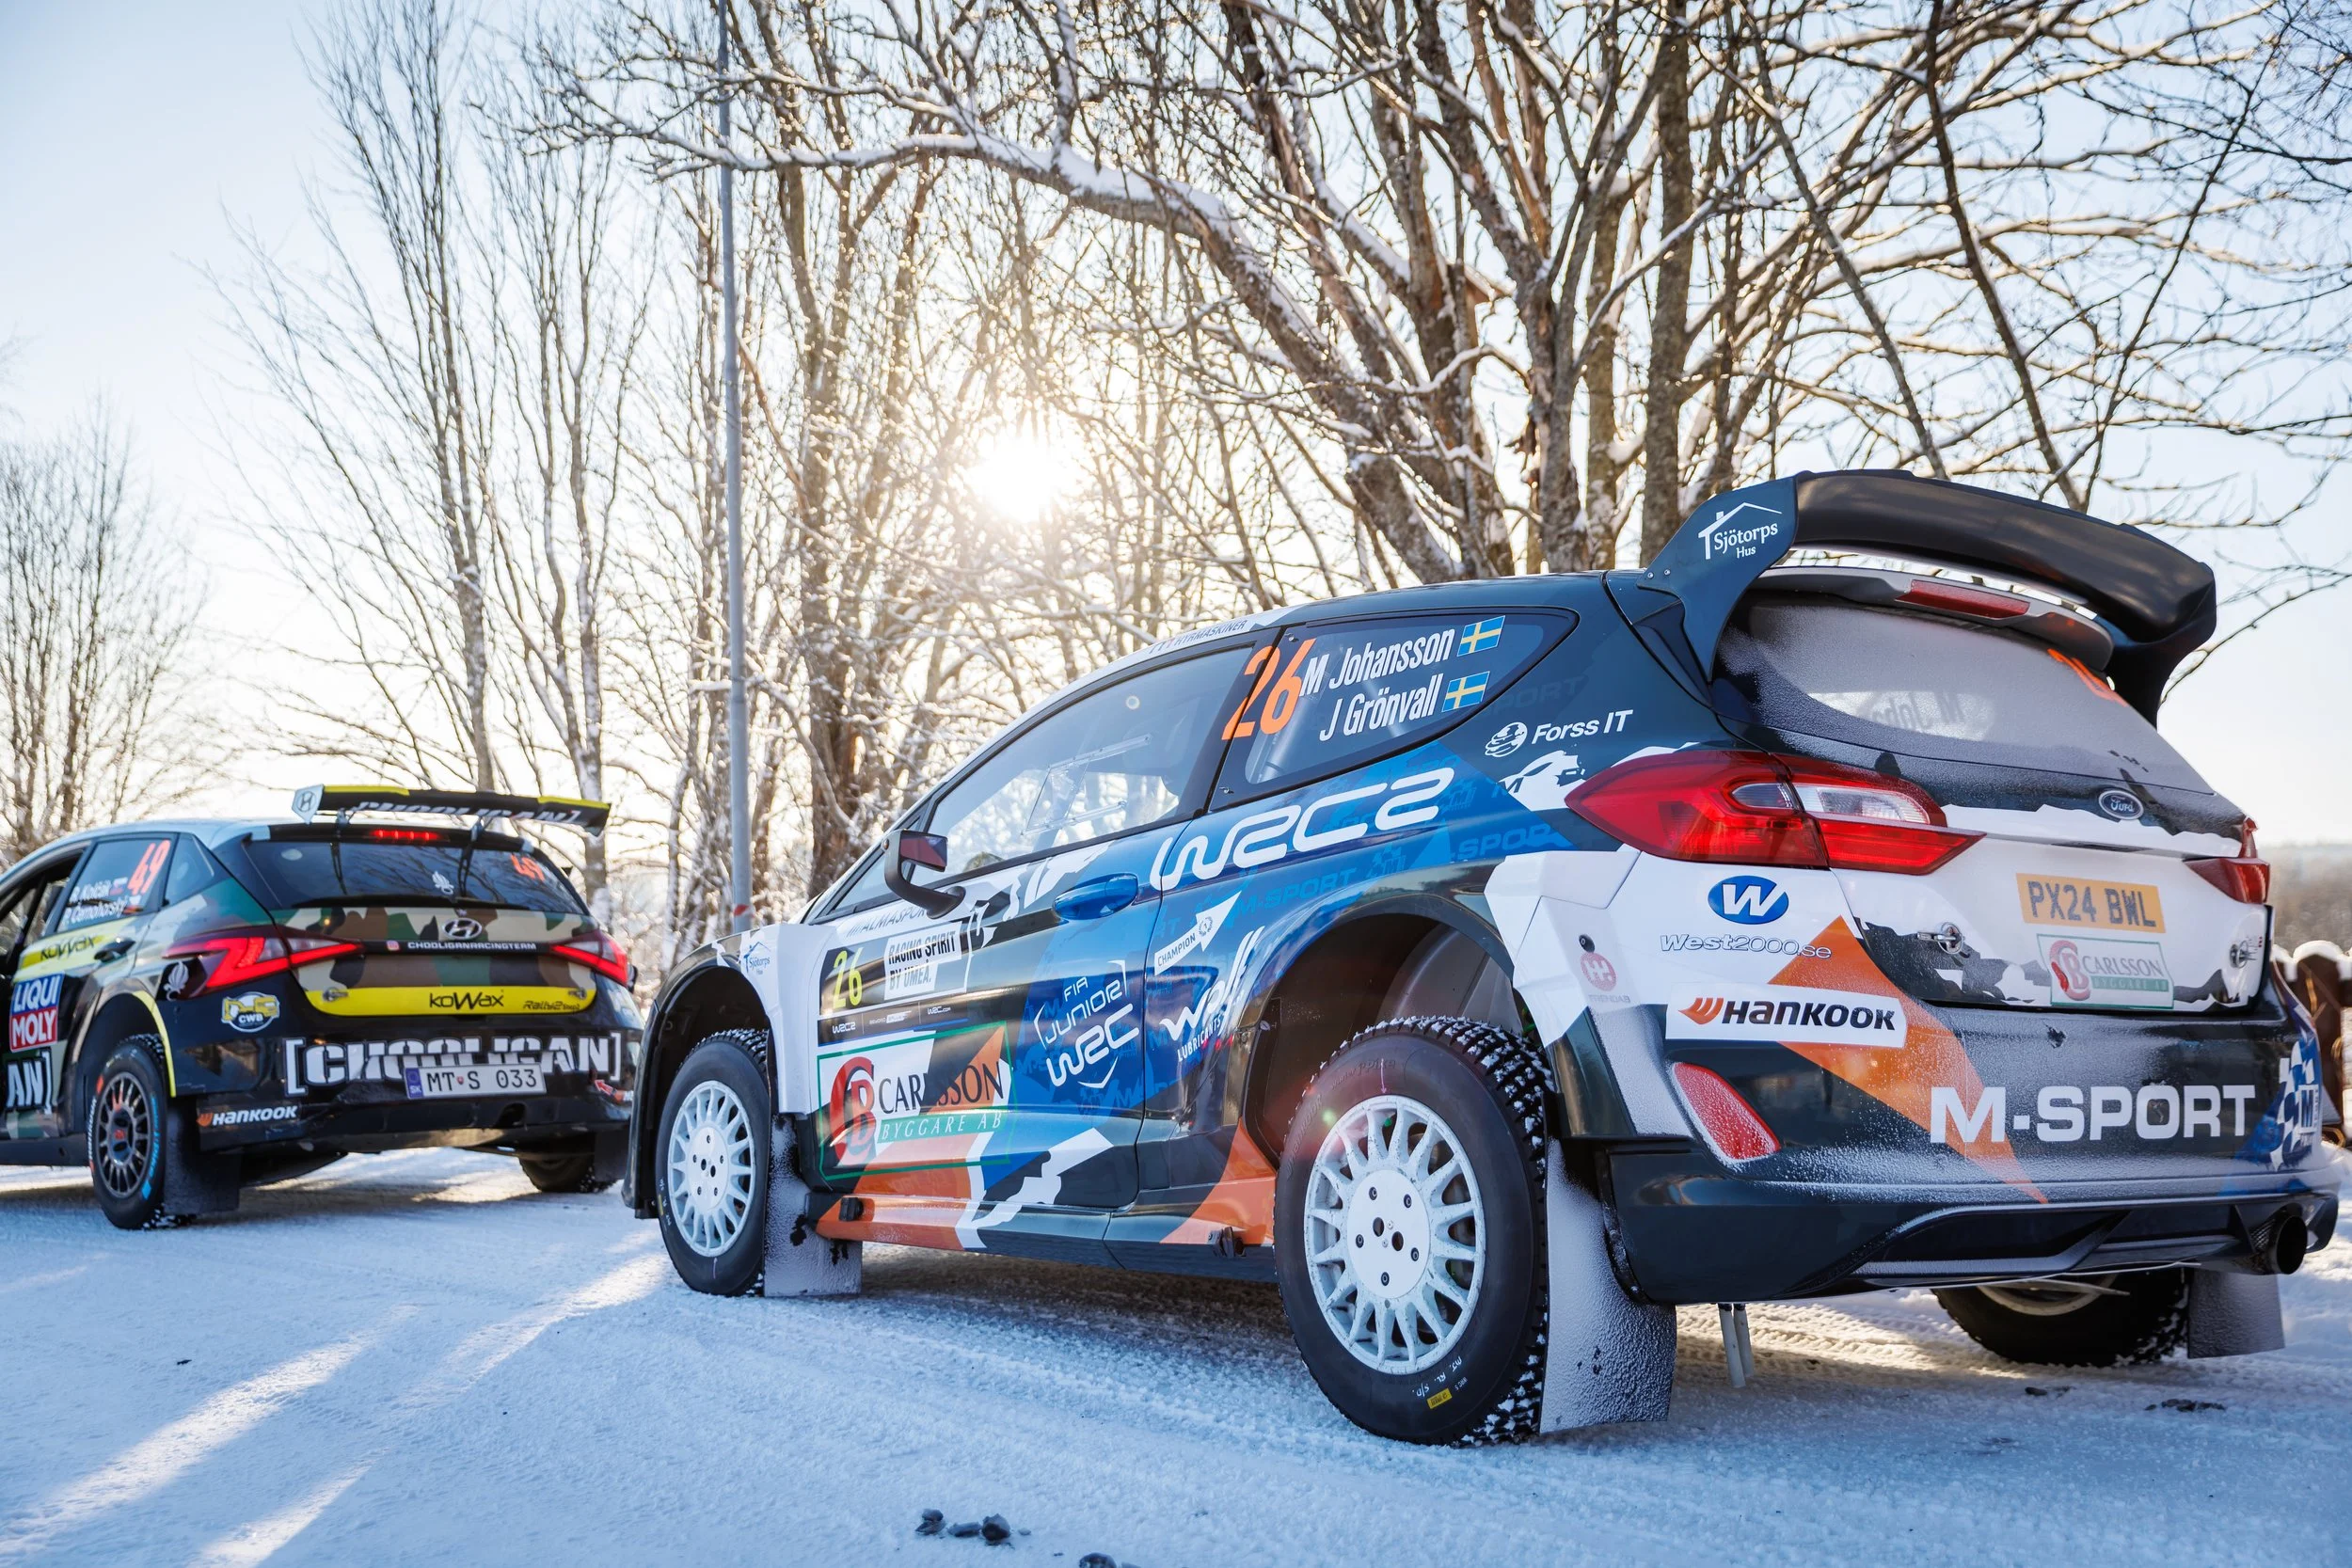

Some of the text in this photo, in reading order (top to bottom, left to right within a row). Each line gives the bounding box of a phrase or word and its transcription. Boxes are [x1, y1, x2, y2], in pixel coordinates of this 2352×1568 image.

[1713, 523, 1778, 554] Sjötorps
[1735, 546, 1756, 559] Hus
[1299, 628, 1455, 697] M Johansson
[1221, 638, 1316, 740] 26
[1319, 673, 1444, 741] J Grönvall
[1531, 709, 1634, 744] Forss IT
[1149, 767, 1455, 891] WRC2
[128, 839, 171, 895] 49
[2027, 880, 2157, 927] PX24 BWL
[888, 930, 956, 965] RACING SPIRIT
[1157, 932, 1197, 967] CHAMPION
[1660, 934, 1832, 958] West2000.se
[833, 947, 864, 1009] 26
[889, 958, 931, 990] BY UMEÅ.
[2081, 955, 2165, 977] CARLSSON
[14, 974, 62, 1013] LIQUI
[1064, 976, 1089, 1003] FIA
[11, 1009, 57, 1048] MOLY
[238, 1012, 263, 1024] CWB
[1044, 979, 1123, 1044] JUNIOR
[1046, 1003, 1140, 1087] WRC
[1177, 1014, 1222, 1063] LUBRICANTS
[409, 1085, 421, 1094] SK
[426, 1069, 537, 1092] MT S 033
[882, 1113, 1003, 1141] BYGGARE AB
[1930, 1084, 2256, 1143] M-SPORT
